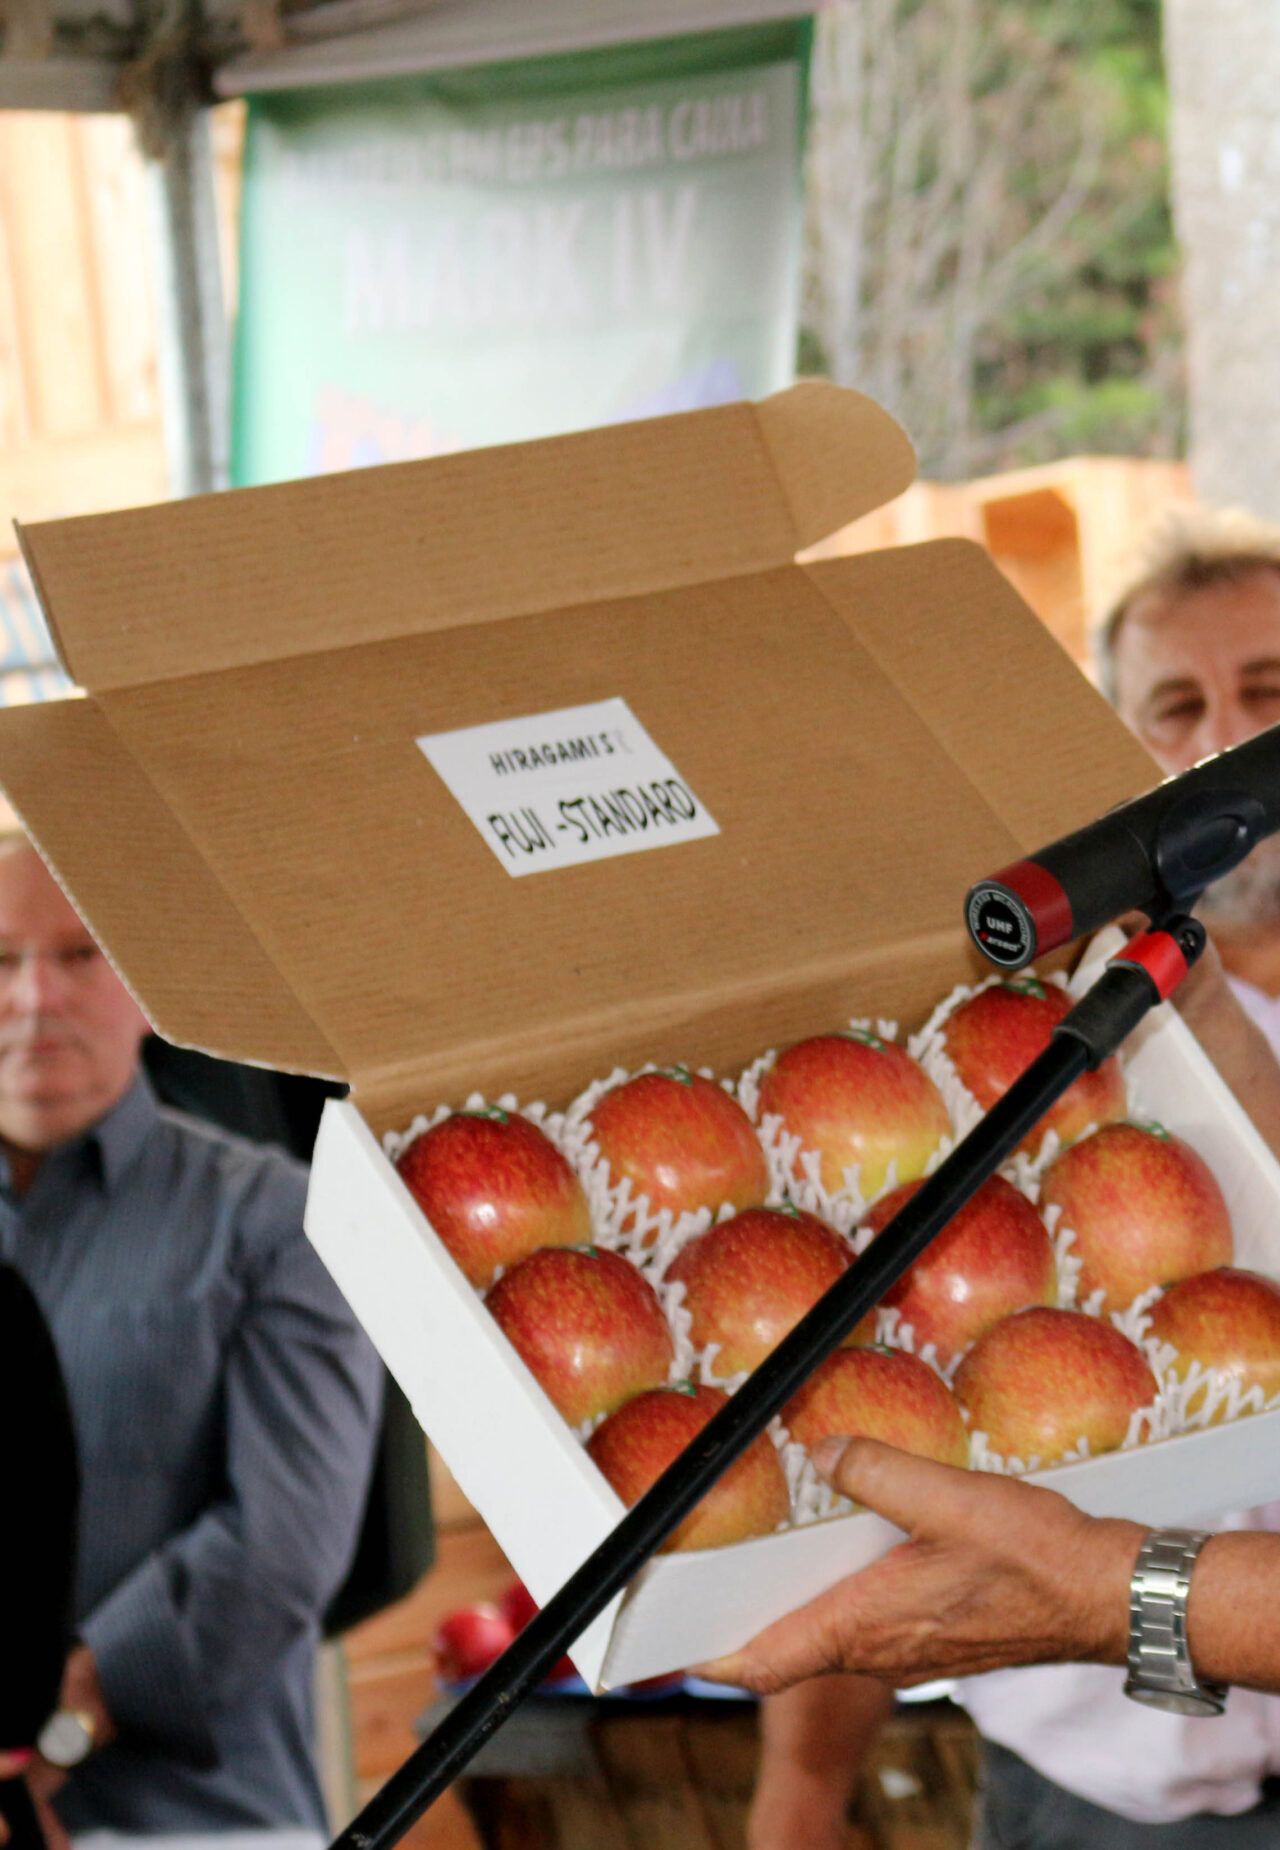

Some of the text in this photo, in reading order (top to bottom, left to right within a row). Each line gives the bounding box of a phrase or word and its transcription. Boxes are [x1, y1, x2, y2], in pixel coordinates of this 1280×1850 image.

[342, 183, 699, 337] MARK IV
[986, 916, 1013, 934] UHF
